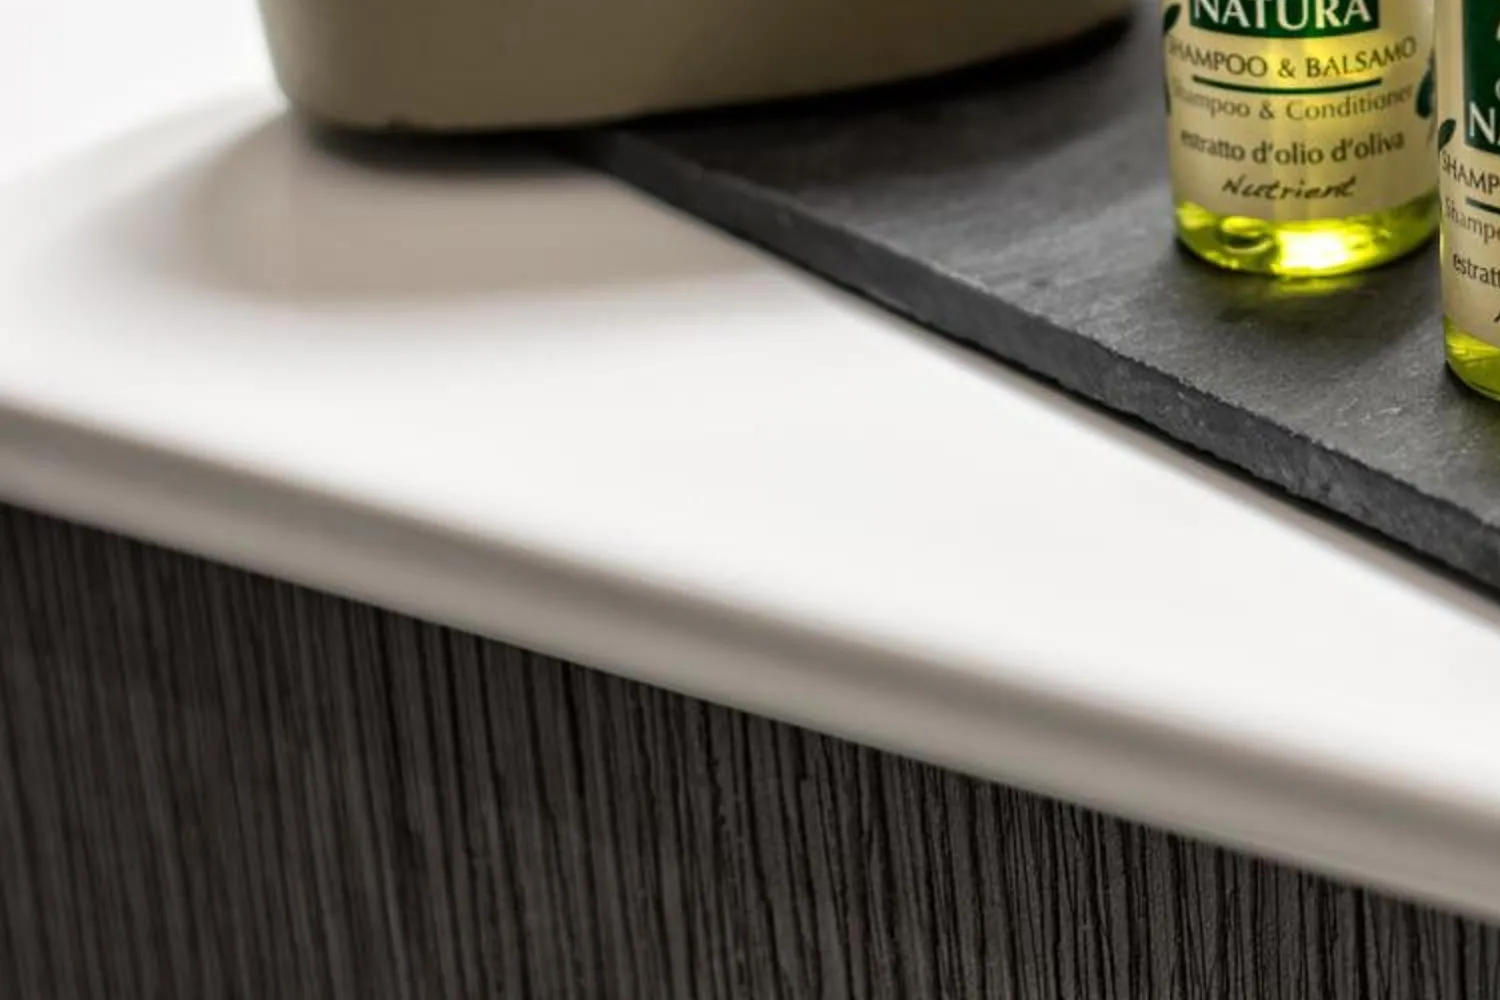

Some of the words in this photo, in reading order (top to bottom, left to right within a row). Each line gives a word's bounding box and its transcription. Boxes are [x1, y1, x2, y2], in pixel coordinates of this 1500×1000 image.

[1278, 58, 1296, 78] &
[1307, 36, 1417, 78] BALSAMO
[1259, 102, 1275, 120] &
[1286, 82, 1414, 121] Conditioner
[1221, 174, 1357, 200] Nutrient
